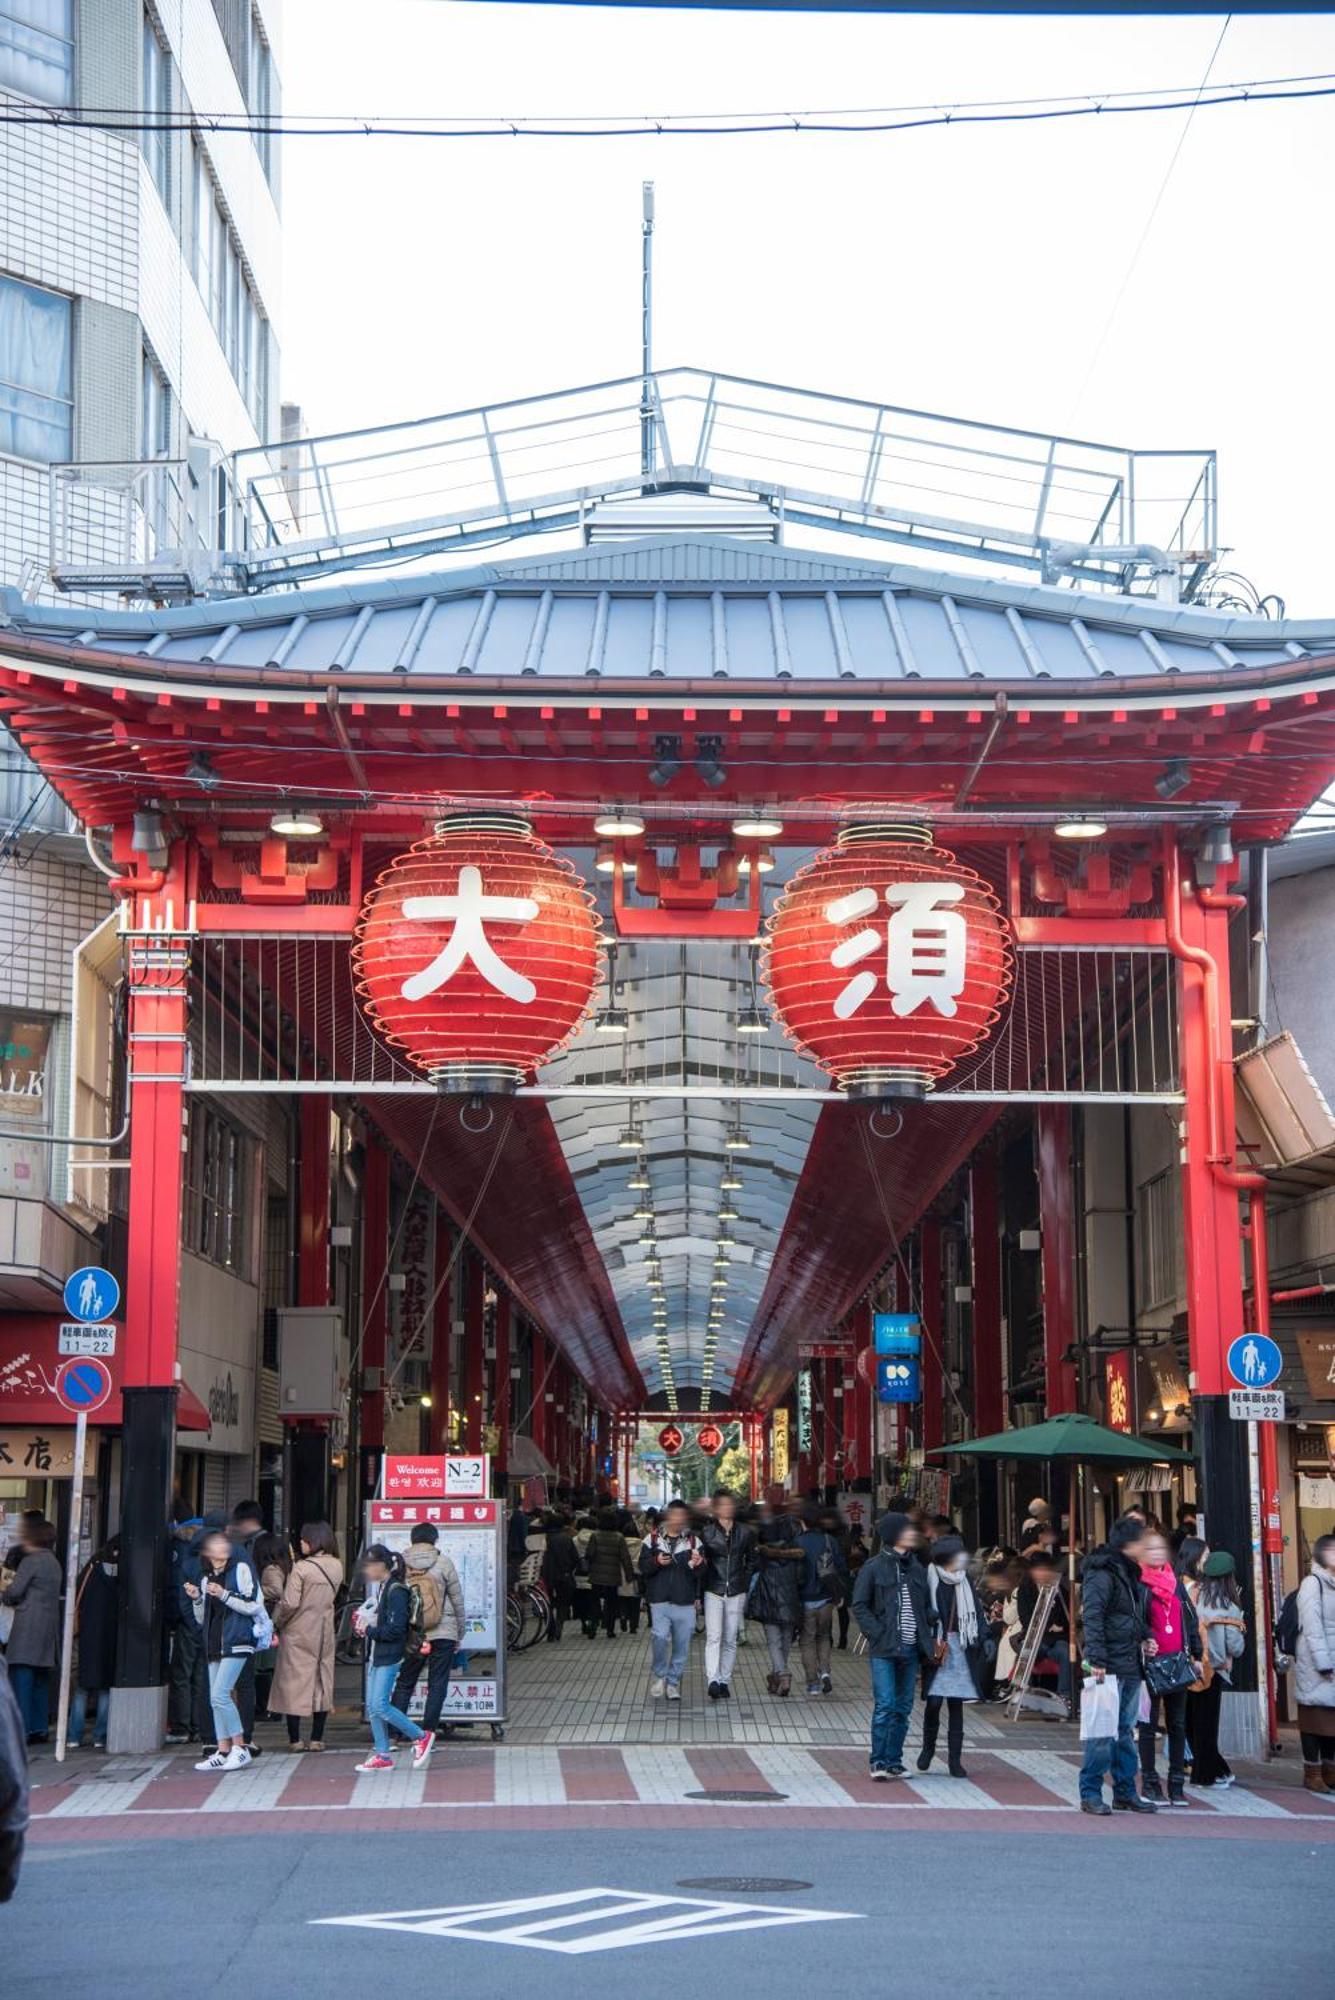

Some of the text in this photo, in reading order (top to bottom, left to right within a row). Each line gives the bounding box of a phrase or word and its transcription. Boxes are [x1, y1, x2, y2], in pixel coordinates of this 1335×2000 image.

[401, 866, 540, 1003] 大
[827, 882, 966, 1020] 須
[65, 1341, 108, 1353] 11-22
[1236, 1406, 1279, 1418] 11-22
[396, 1464, 440, 1475] Welcome
[447, 1463, 481, 1477] N-2
